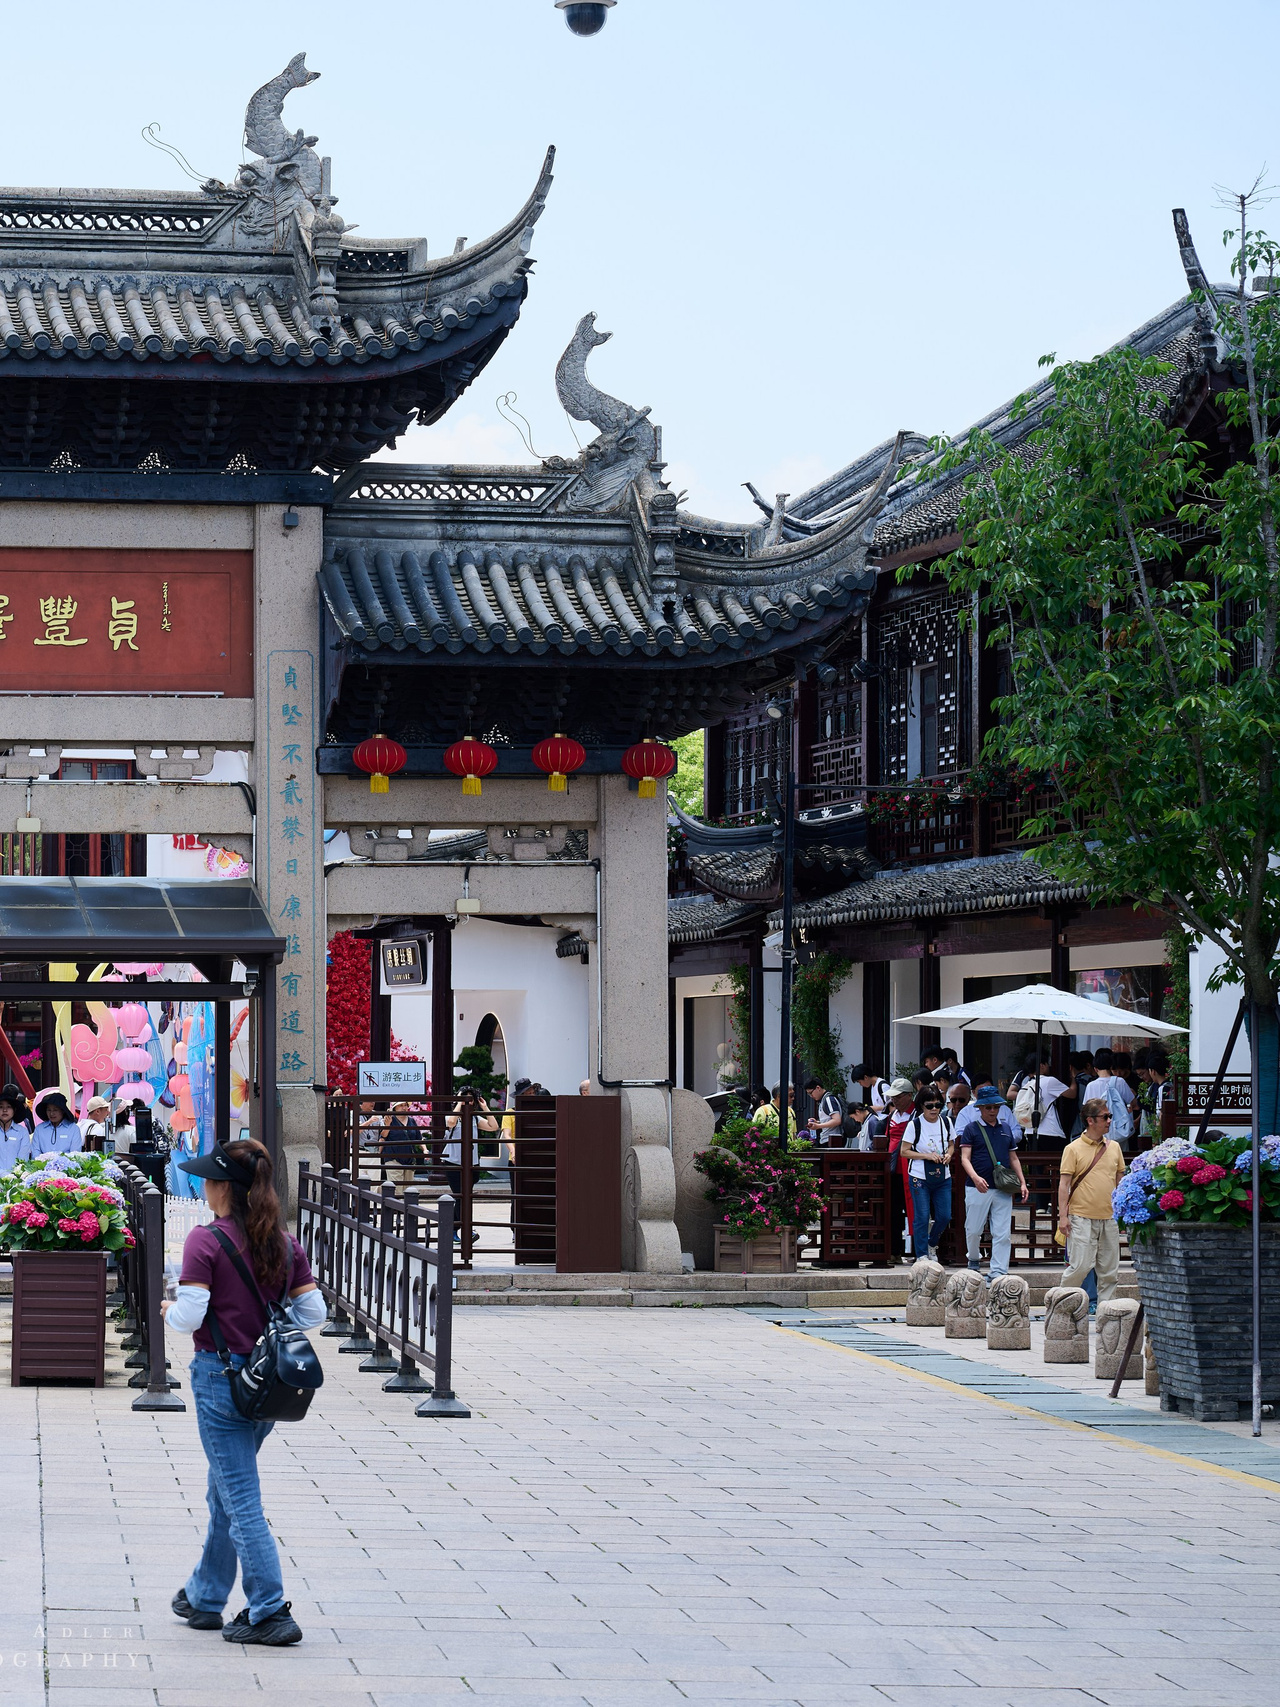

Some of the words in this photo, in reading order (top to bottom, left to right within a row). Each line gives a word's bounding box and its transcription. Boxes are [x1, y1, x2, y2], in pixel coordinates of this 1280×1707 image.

[382, 1072, 422, 1082] 游客止步
[1187, 1084, 1252, 1095] 景区业时间
